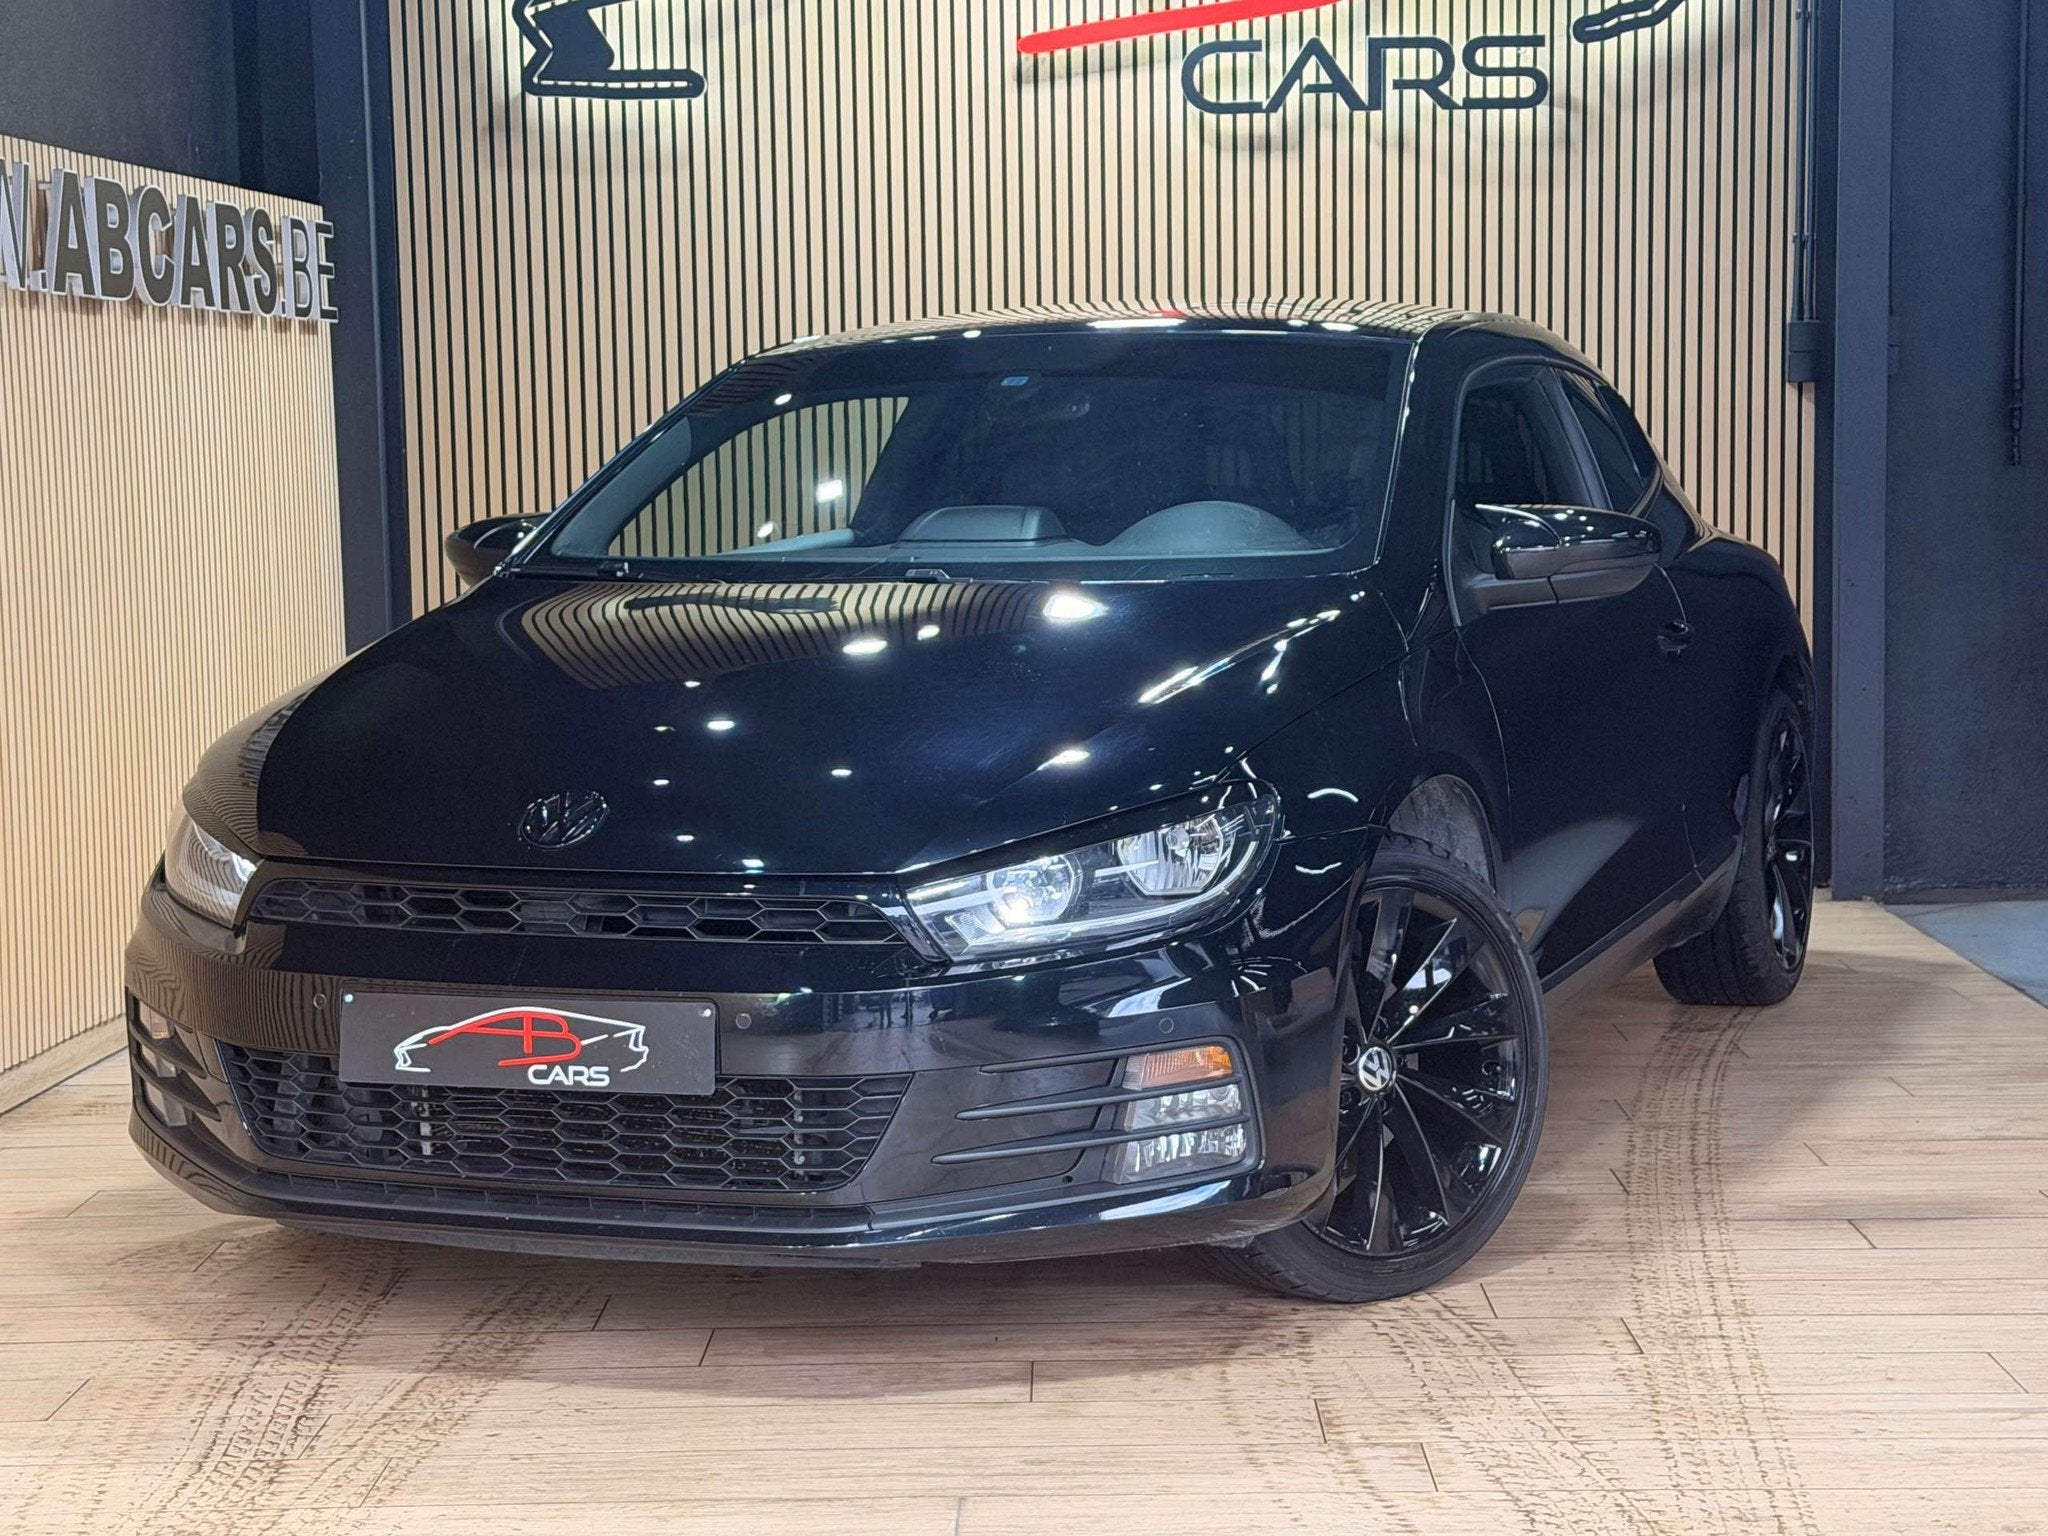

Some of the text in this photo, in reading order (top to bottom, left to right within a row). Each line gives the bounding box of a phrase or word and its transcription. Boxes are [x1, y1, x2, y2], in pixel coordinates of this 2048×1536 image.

[1180, 35, 1550, 114] CARS
[527, 1064, 611, 1088] CARS
[1358, 1046, 1392, 1091] VW
